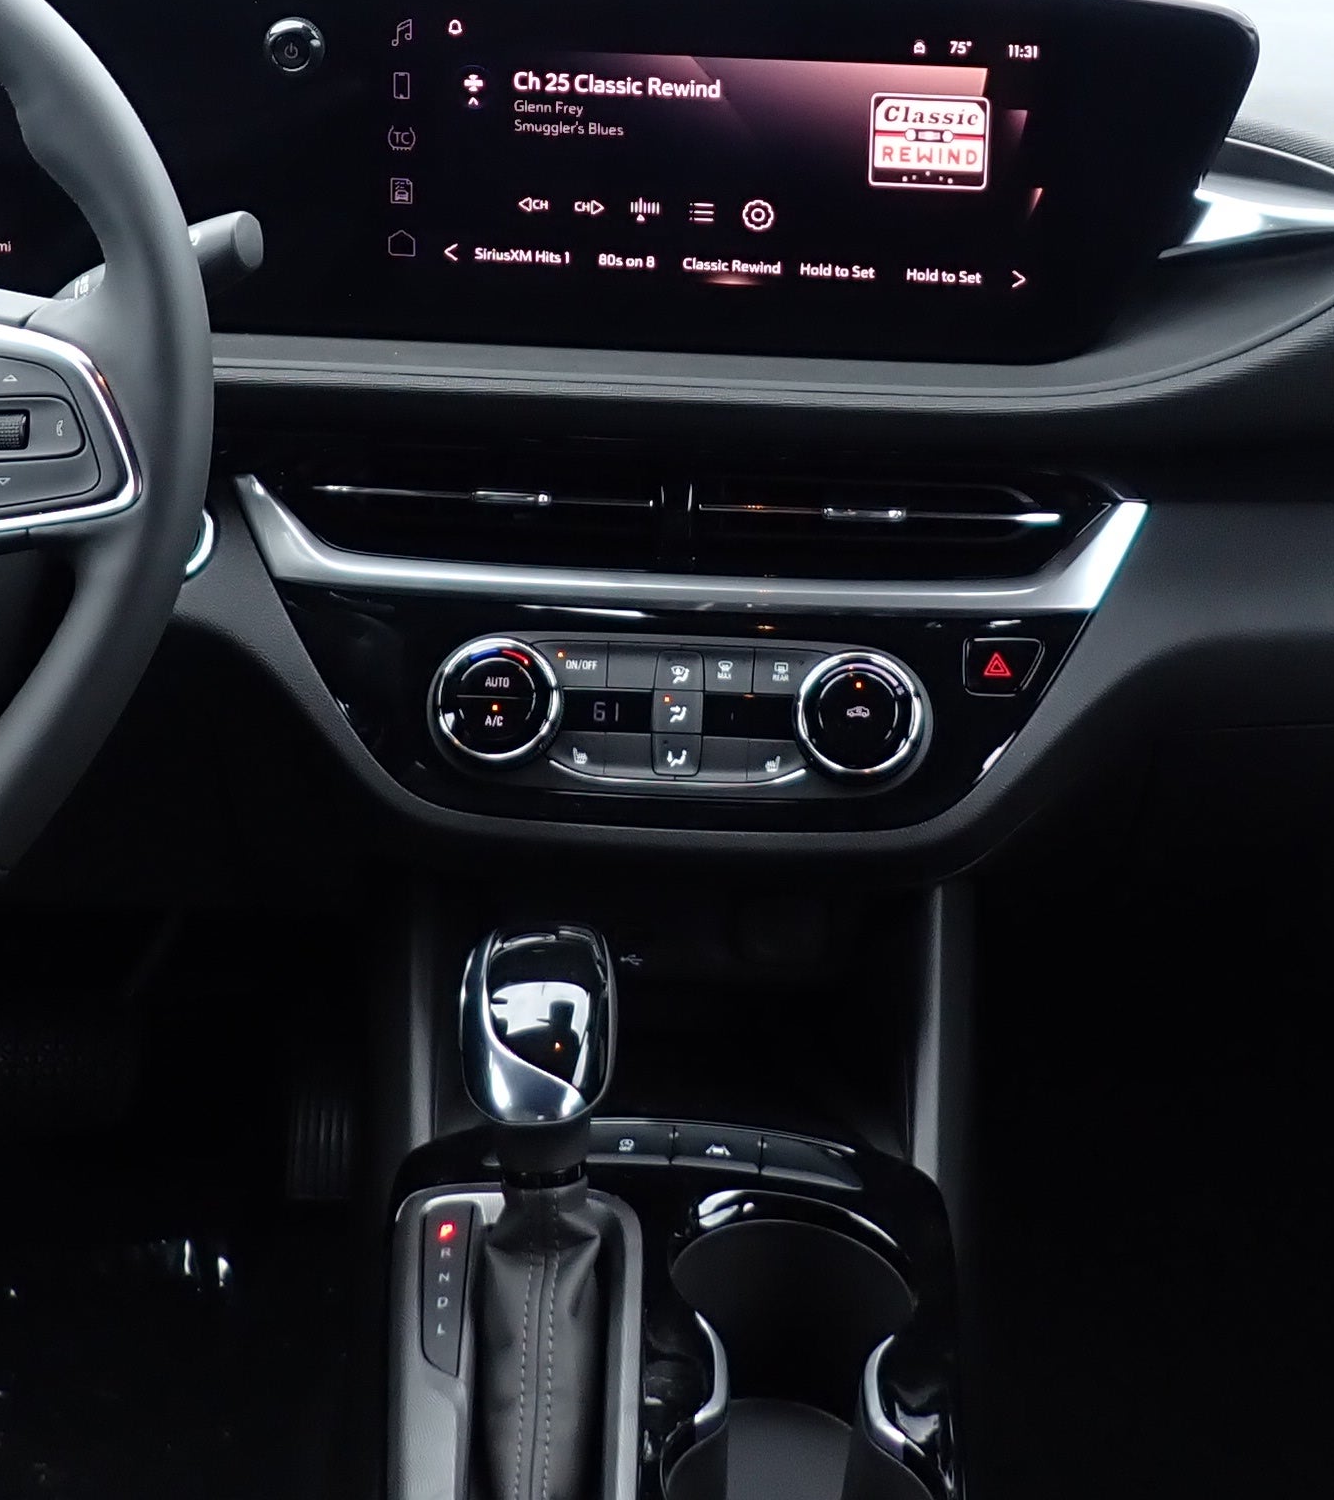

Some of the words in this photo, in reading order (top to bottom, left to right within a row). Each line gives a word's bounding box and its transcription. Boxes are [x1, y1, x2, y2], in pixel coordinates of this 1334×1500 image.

[950, 41, 972, 54] 75°
[1008, 44, 1038, 58] 11:31
[514, 71, 540, 90] Ch
[545, 73, 569, 92] 25
[574, 74, 643, 95] Classic
[648, 77, 721, 98] Rewind
[514, 100, 551, 113] Glenn
[556, 101, 583, 117] Frey
[884, 105, 978, 125] Classic
[514, 119, 585, 136] Smuggler's
[589, 123, 624, 136] Blues
[882, 146, 977, 165] REWIND
[532, 199, 548, 210] CH
[574, 201, 590, 212] CH
[475, 248, 532, 262] SiriusXM
[535, 251, 561, 263] Hits
[599, 254, 622, 266] 80s
[626, 257, 643, 267] on
[646, 256, 655, 268] 8
[683, 257, 729, 271] Classic
[732, 260, 781, 274] Rewind
[800, 262, 831, 277] Hold
[835, 266, 849, 277] to
[852, 266, 875, 279] Set
[906, 268, 938, 282] Hold
[941, 271, 955, 282] to
[959, 271, 981, 284] Set
[566, 659, 598, 670] ON/OFF
[717, 671, 731, 680] MAX
[772, 673, 788, 681] REAR
[485, 677, 510, 688] AUTO
[485, 715, 504, 726] A/C
[440, 1247, 451, 1258] R
[439, 1272, 450, 1282] N
[437, 1297, 448, 1308] D
[437, 1324, 445, 1334] L
